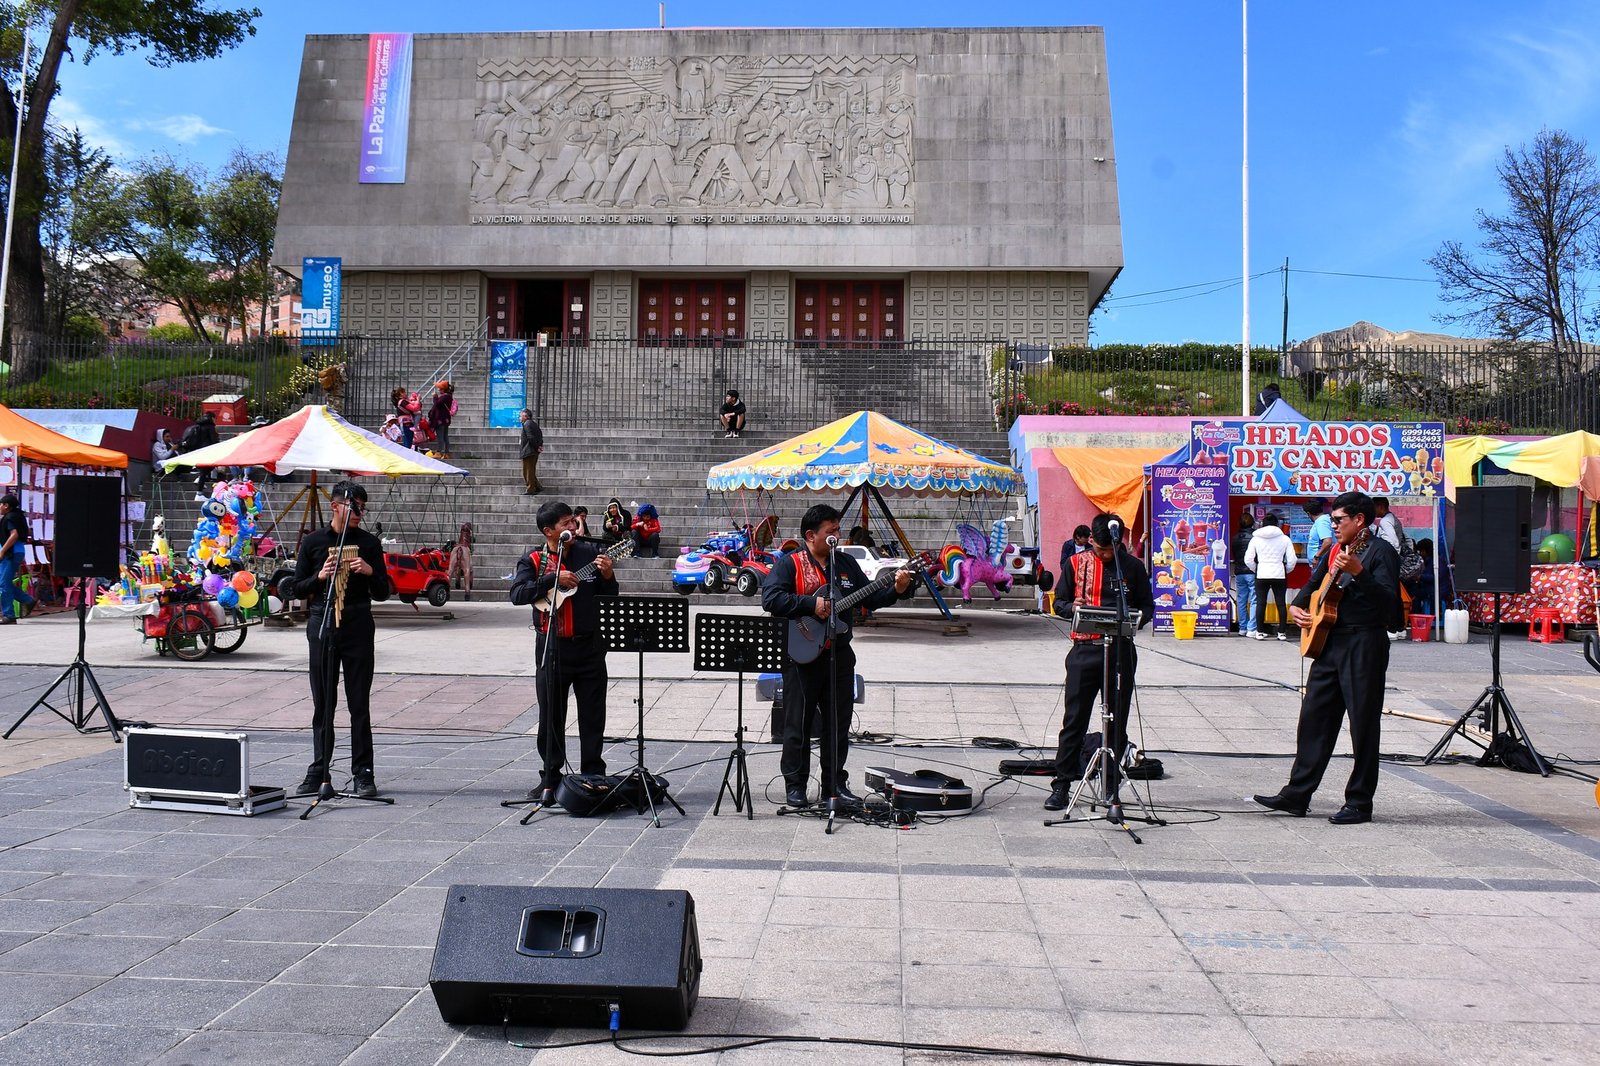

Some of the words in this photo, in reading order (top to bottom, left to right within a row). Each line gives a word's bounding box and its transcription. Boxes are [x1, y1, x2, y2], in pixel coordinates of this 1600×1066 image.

[373, 40, 382, 83] Iberoamericano
[379, 40, 390, 77] Culturas
[371, 84, 379, 104] Capital
[378, 78, 388, 90] las
[379, 92, 386, 104] de
[369, 107, 385, 133] Paz
[368, 137, 383, 154] La
[471, 216, 484, 224] LA
[486, 216, 523, 224] VICTORIA
[322, 265, 332, 309] museo
[1245, 425, 1389, 446] HELADOS
[1234, 449, 1274, 468] DE
[1281, 449, 1400, 470] CANELA
[1154, 467, 1226, 478] HELADERIA
[1184, 492, 1213, 500] Reyna
[143, 749, 225, 776] Abdias
